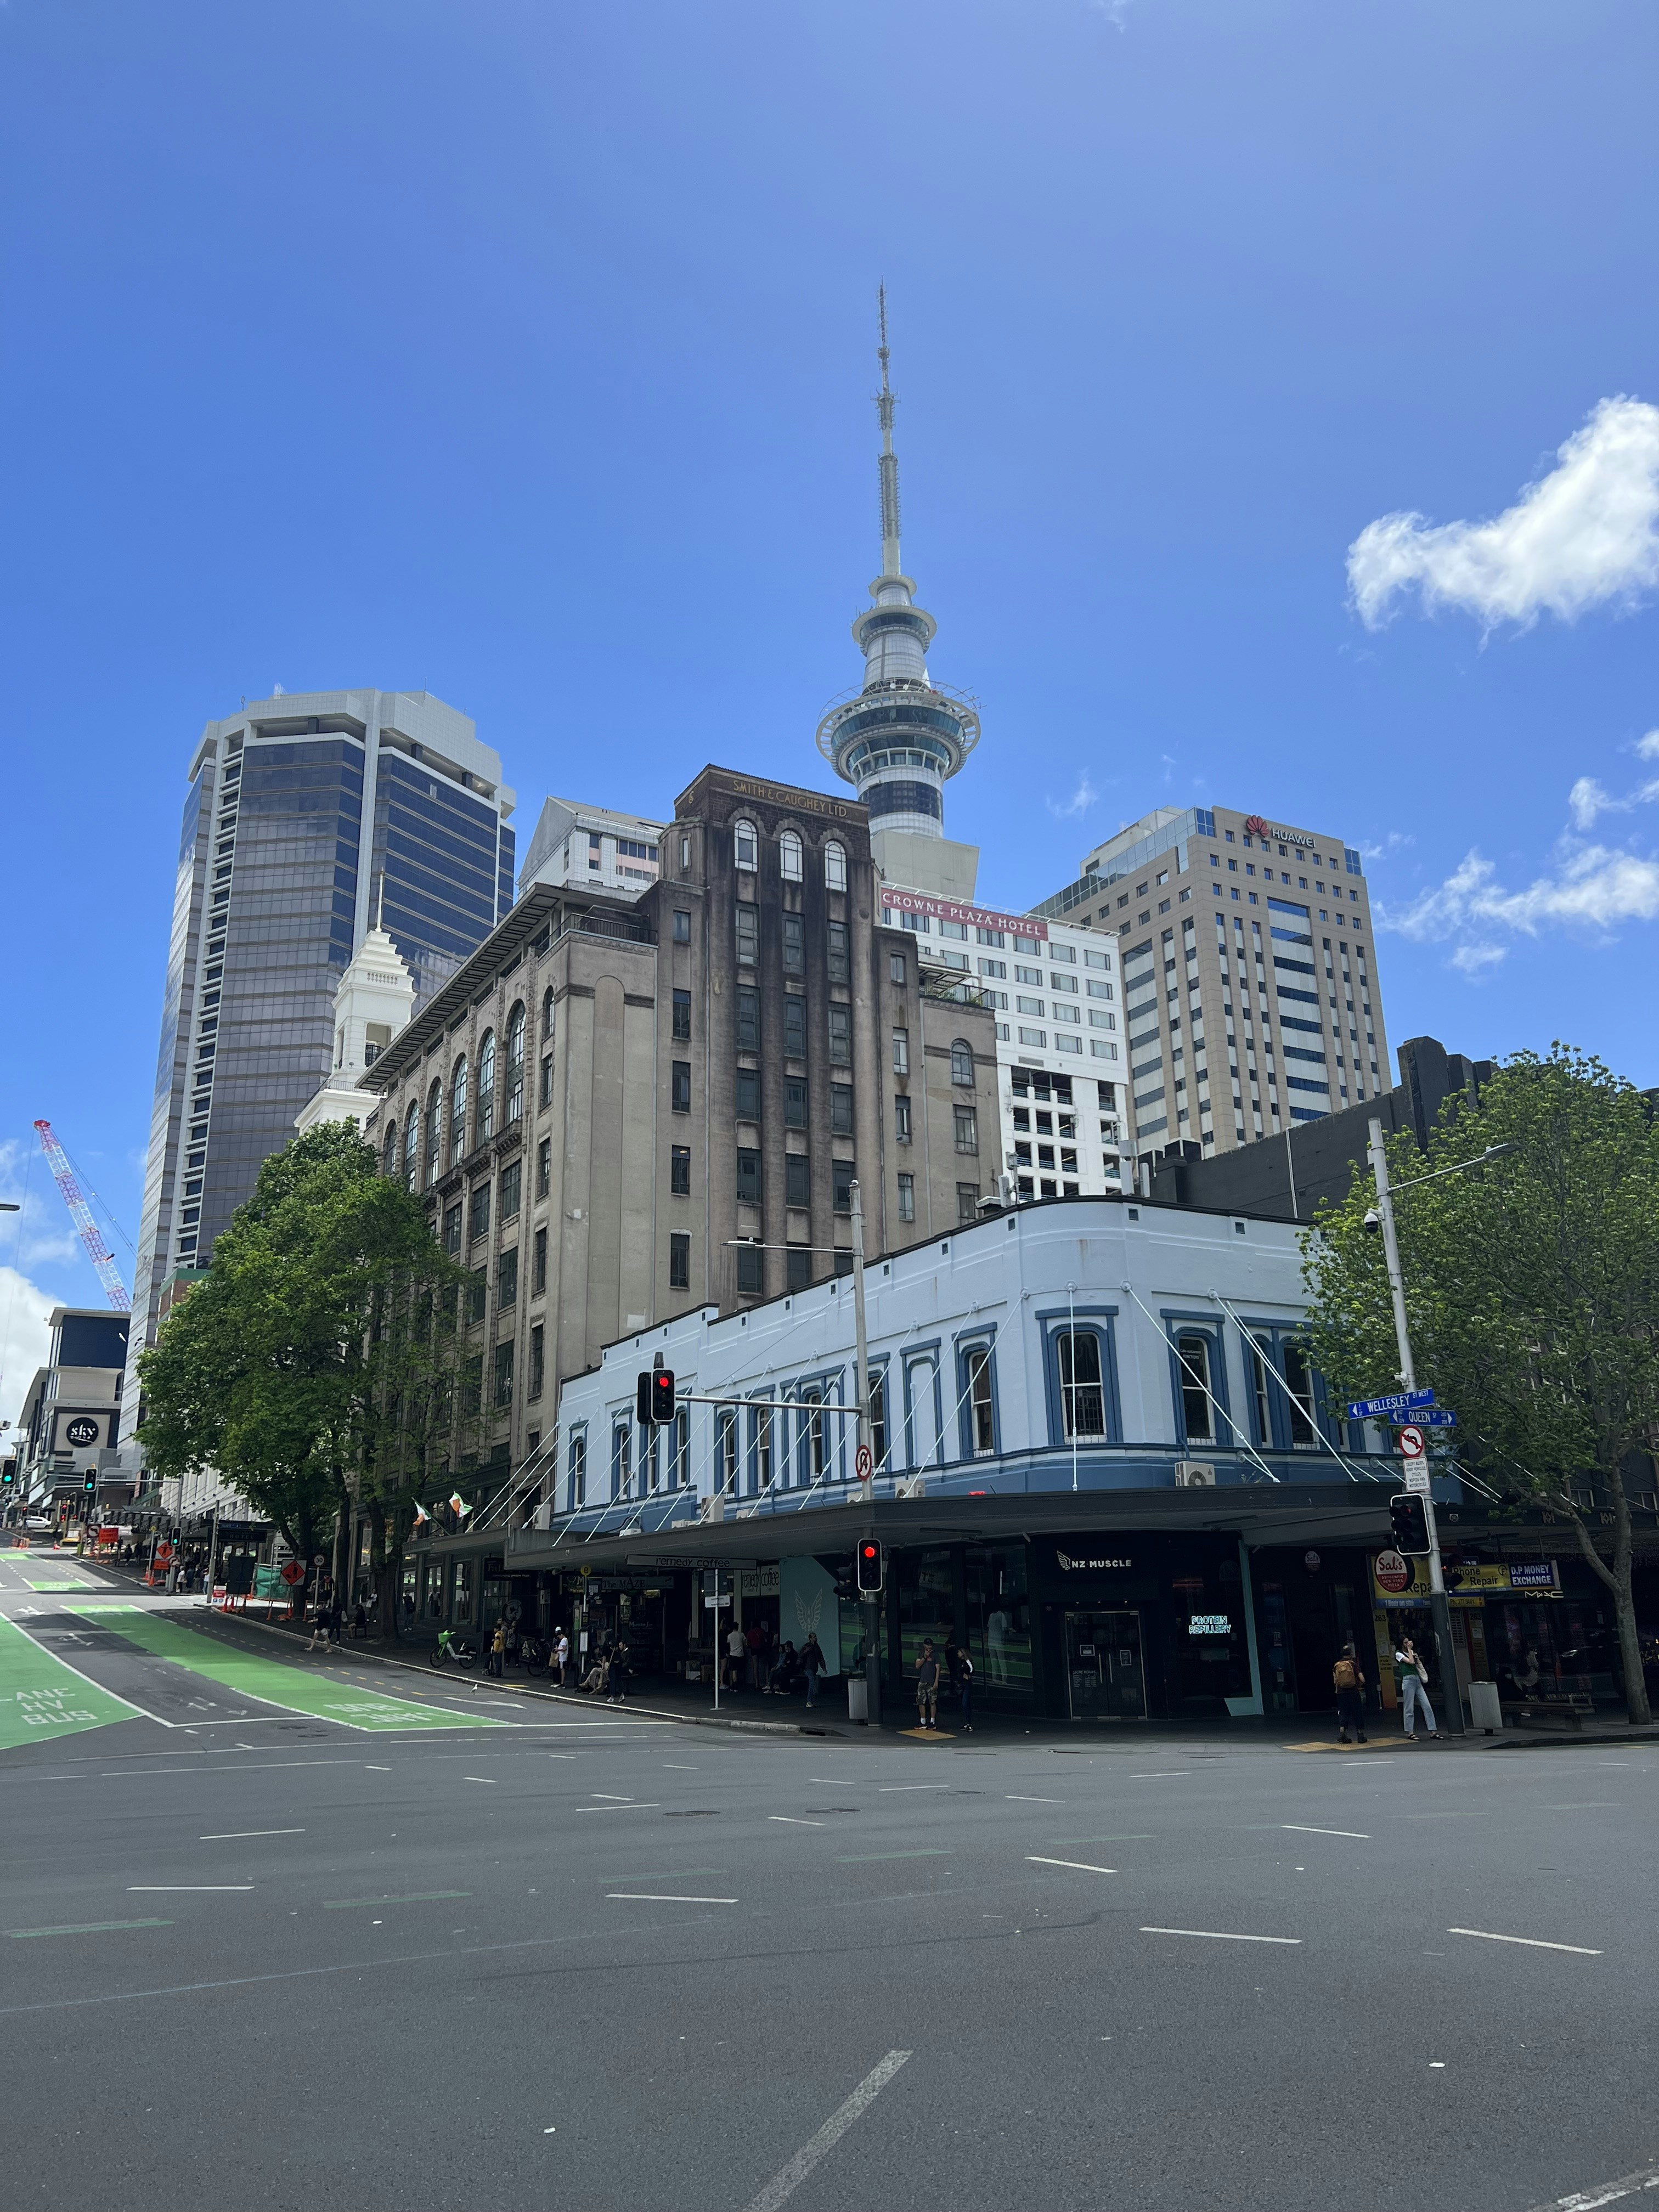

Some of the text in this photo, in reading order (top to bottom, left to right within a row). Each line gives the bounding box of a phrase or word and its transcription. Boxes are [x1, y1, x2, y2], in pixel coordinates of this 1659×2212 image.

[776, 791, 825, 812] CAUGHEY
[1271, 828, 1317, 848] HUAWEI
[882, 893, 1041, 936] CROWNE PLAZA HOTEL
[1367, 1395, 1410, 1413] WELLESLEY
[1408, 1411, 1431, 1423] QUEEN
[71, 1424, 96, 1436] sky
[656, 1558, 730, 1567] remedy coffee
[1378, 1556, 1403, 1571] Sal's
[1454, 1567, 1480, 1576] Phone
[1510, 1564, 1549, 1575] D.P MONEY
[619, 1577, 645, 1589] MAZE
[761, 1567, 780, 1588] coffee
[1470, 1576, 1498, 1588] Repair
[1512, 1575, 1552, 1585] EXCHANGE
[1191, 1615, 1227, 1625] PROTEIN
[1188, 1624, 1232, 1634] REFILLERY
[21, 1700, 64, 1712] HV
[21, 1710, 98, 1725] BUS
